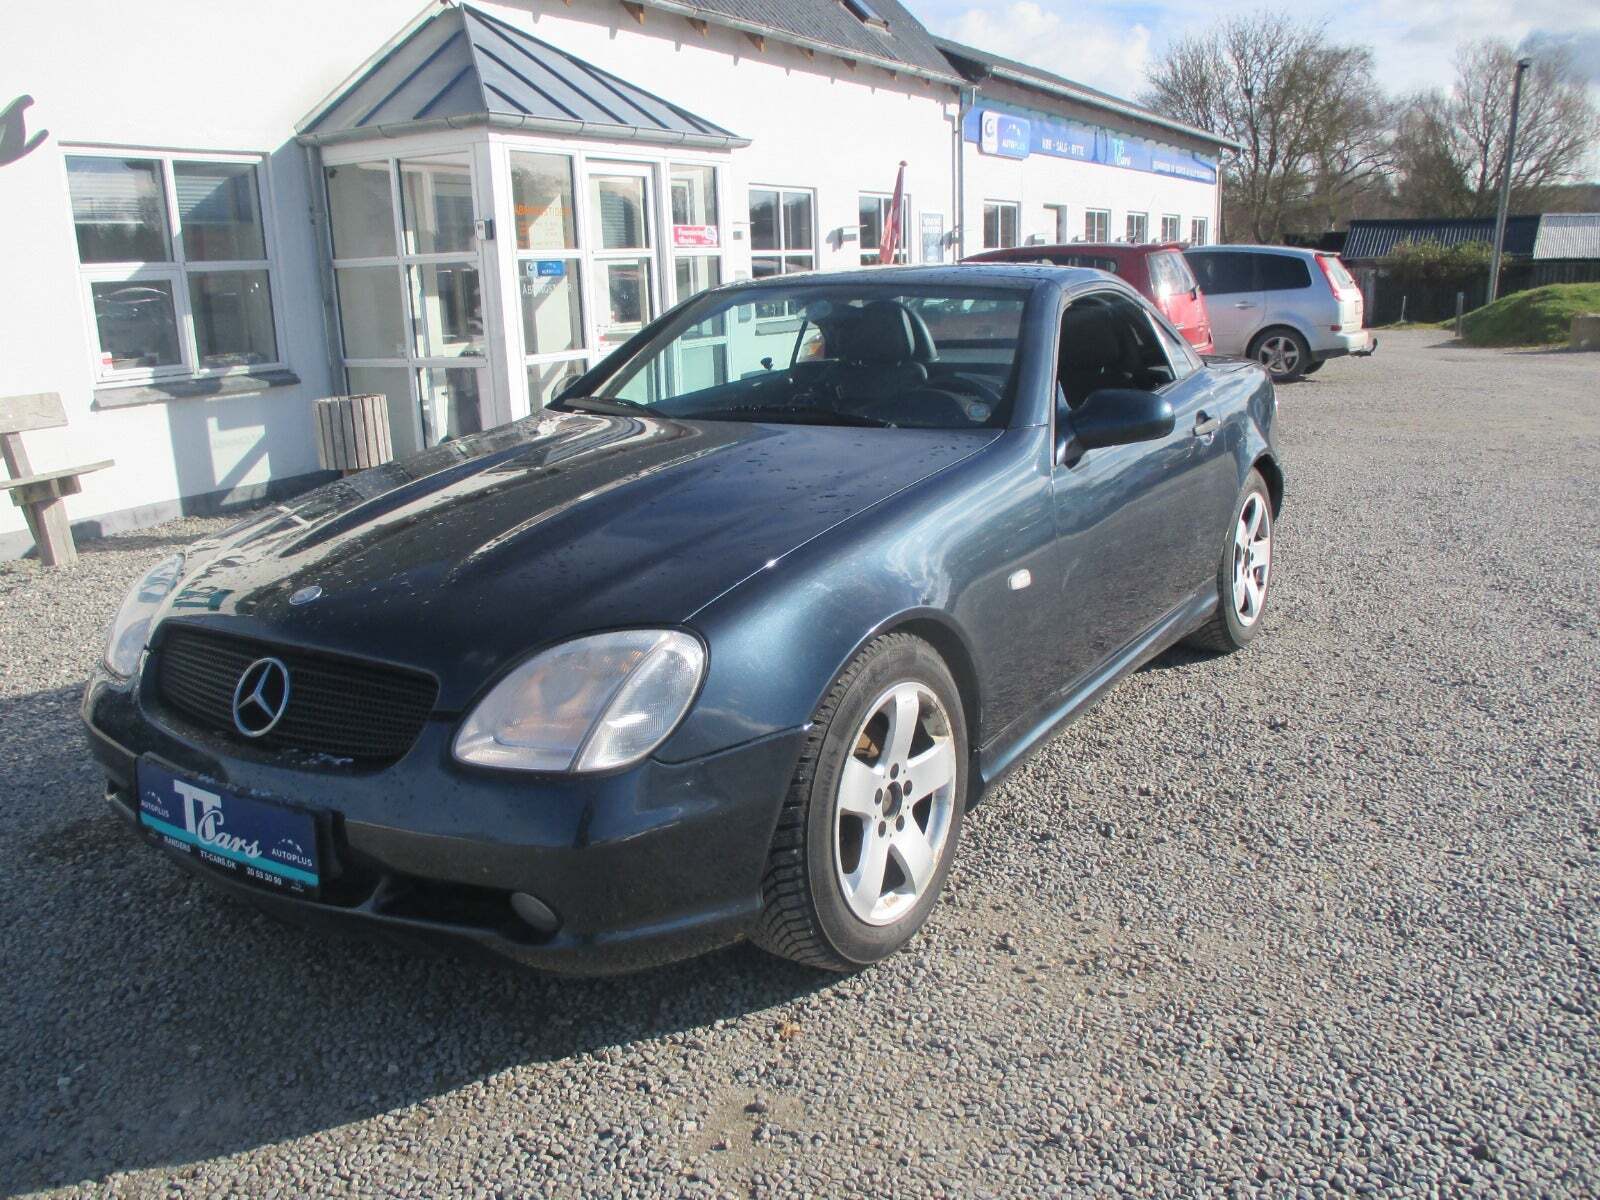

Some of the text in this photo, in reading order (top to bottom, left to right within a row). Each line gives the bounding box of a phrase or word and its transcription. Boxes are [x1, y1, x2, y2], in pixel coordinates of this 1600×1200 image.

[141, 801, 169, 818] AUTOPLUS
[197, 809, 263, 858] Cars
[199, 849, 237, 870] TT-CARS.DK
[271, 848, 313, 867] AUTOPLUS
